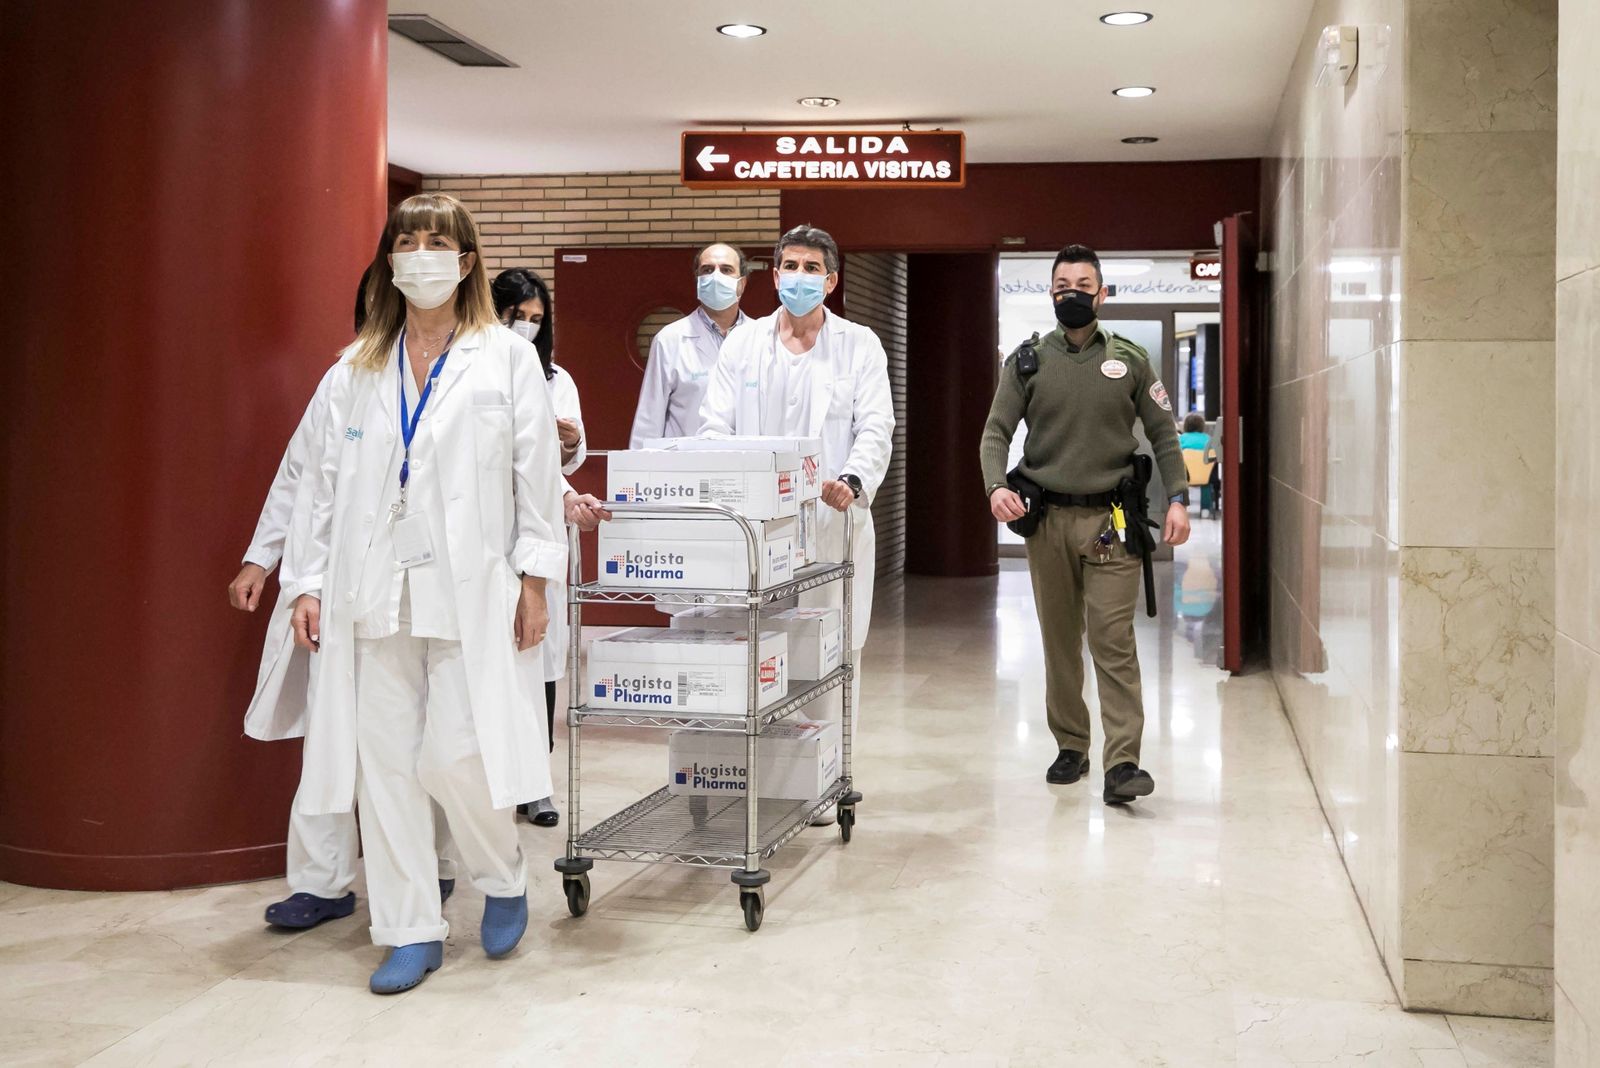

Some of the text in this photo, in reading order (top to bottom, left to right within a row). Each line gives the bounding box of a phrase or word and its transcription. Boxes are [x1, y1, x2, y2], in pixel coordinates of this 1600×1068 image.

[776, 136, 909, 154] SALIDA
[734, 160, 951, 179] CAFETERIA VISITAS
[635, 482, 694, 500] Logista
[626, 550, 684, 567] Logista
[625, 565, 684, 579] Pharma
[614, 674, 672, 692] Logista
[614, 688, 672, 704] Pharma
[693, 762, 746, 779] Logista
[693, 776, 746, 790] Pharma
